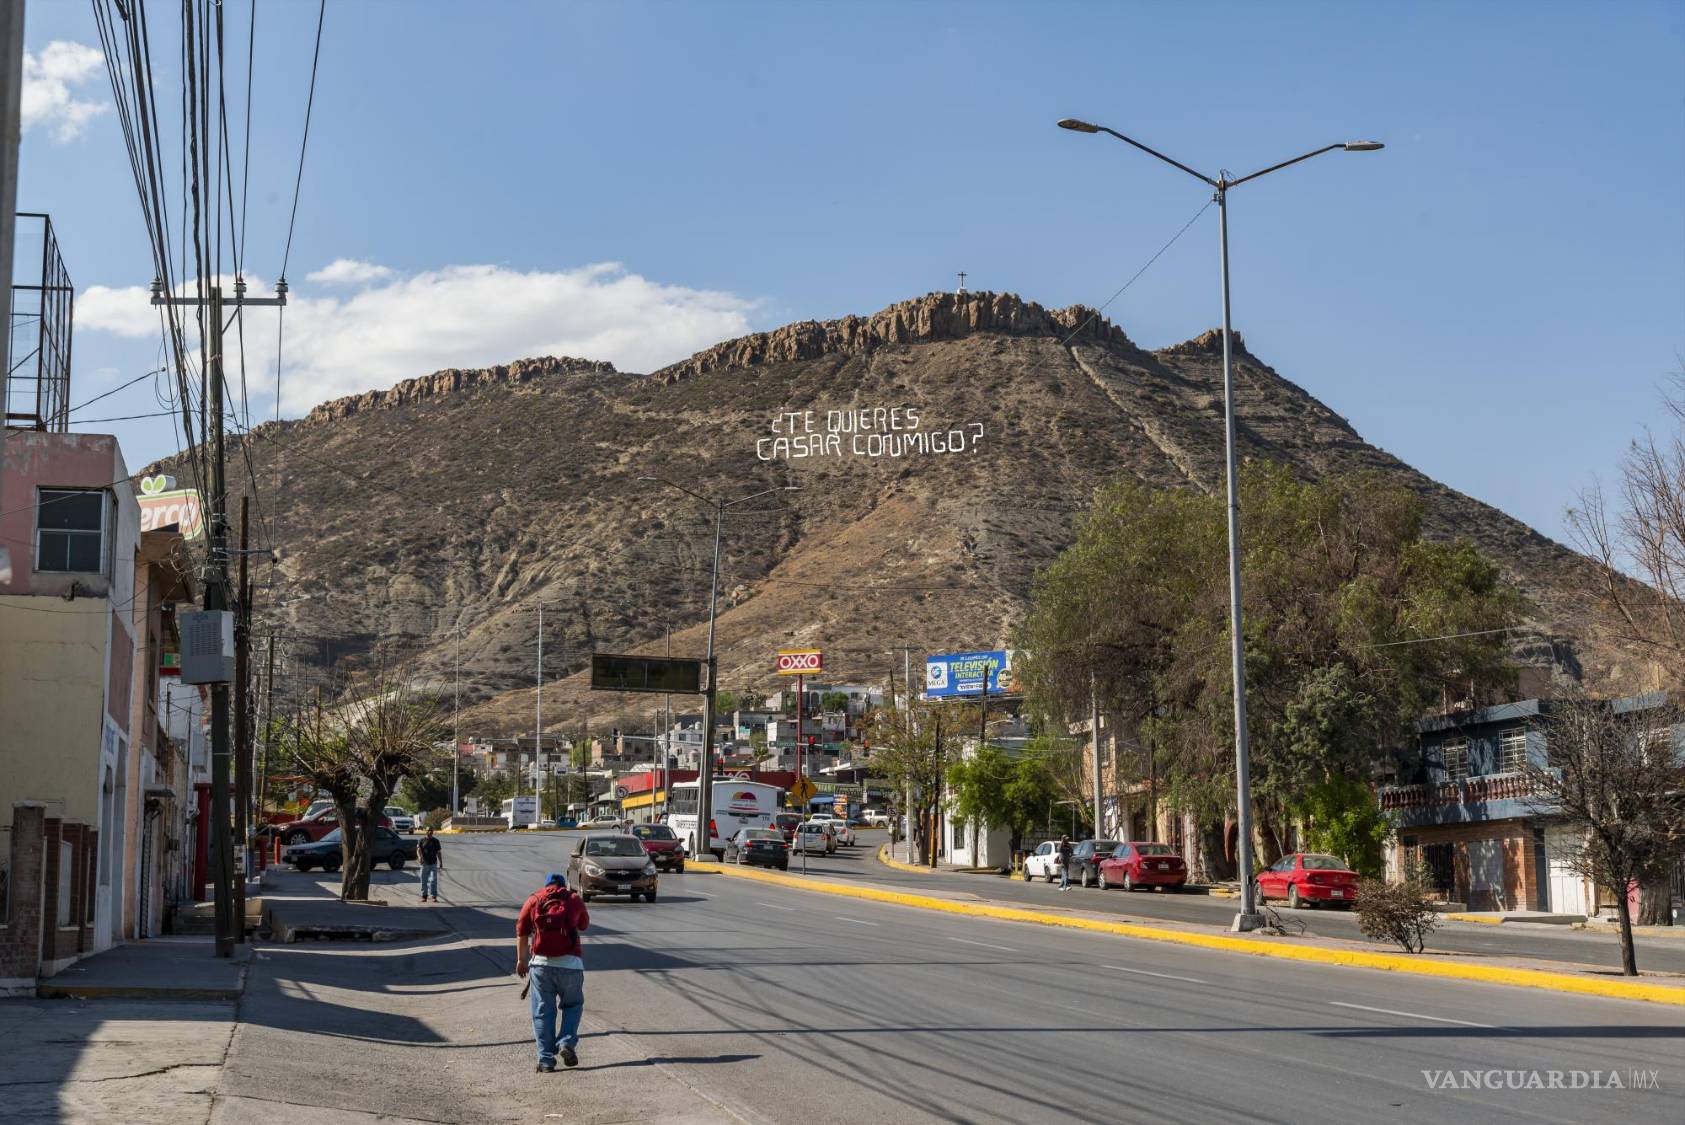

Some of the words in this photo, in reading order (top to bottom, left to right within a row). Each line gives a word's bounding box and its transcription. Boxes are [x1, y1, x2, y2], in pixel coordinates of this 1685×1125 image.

[772, 407, 814, 434] ¿TE
[827, 407, 920, 435] QUIERES
[756, 433, 842, 461] CASAR
[141, 498, 196, 531] erco
[779, 655, 819, 669] OXXO
[950, 657, 999, 673] TELEVISIÓN
